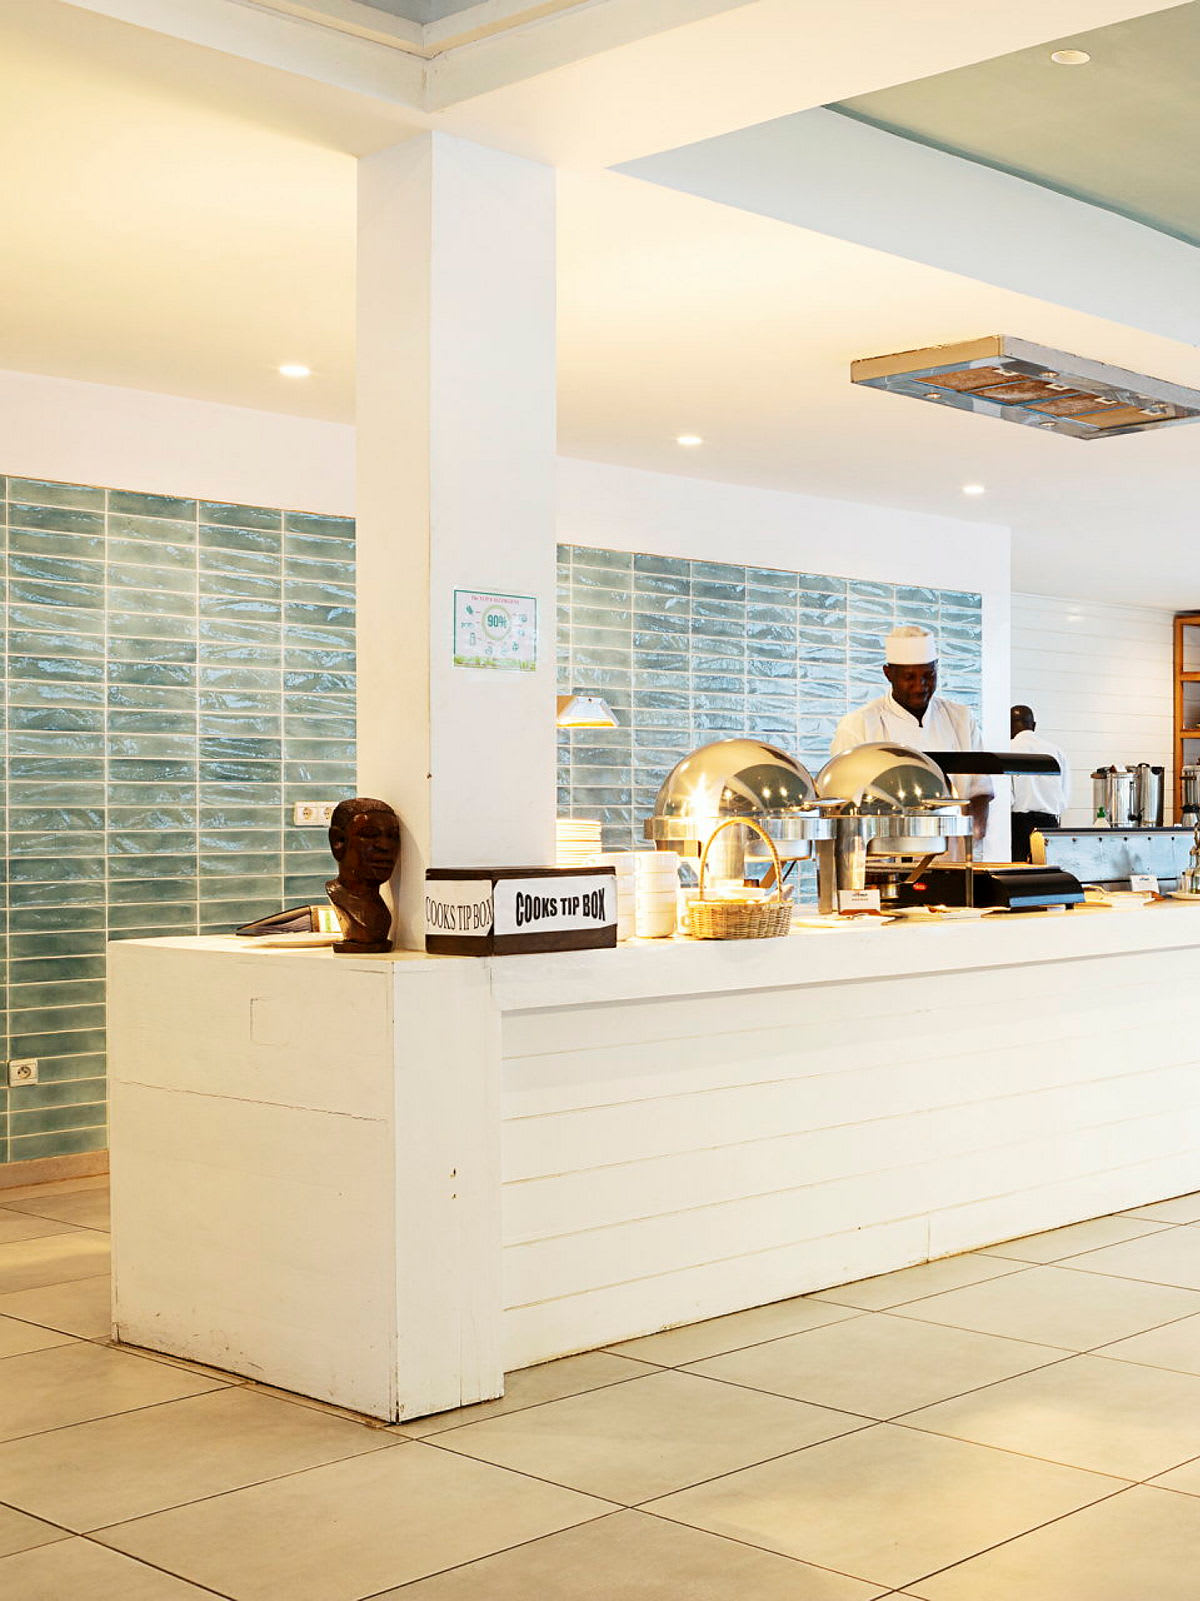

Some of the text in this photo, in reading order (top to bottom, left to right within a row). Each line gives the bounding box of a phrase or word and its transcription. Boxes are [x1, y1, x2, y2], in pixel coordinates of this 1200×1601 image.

[425, 896, 494, 931] COOKS TIP BOX
[516, 887, 606, 927] COOKS TIP BOX
